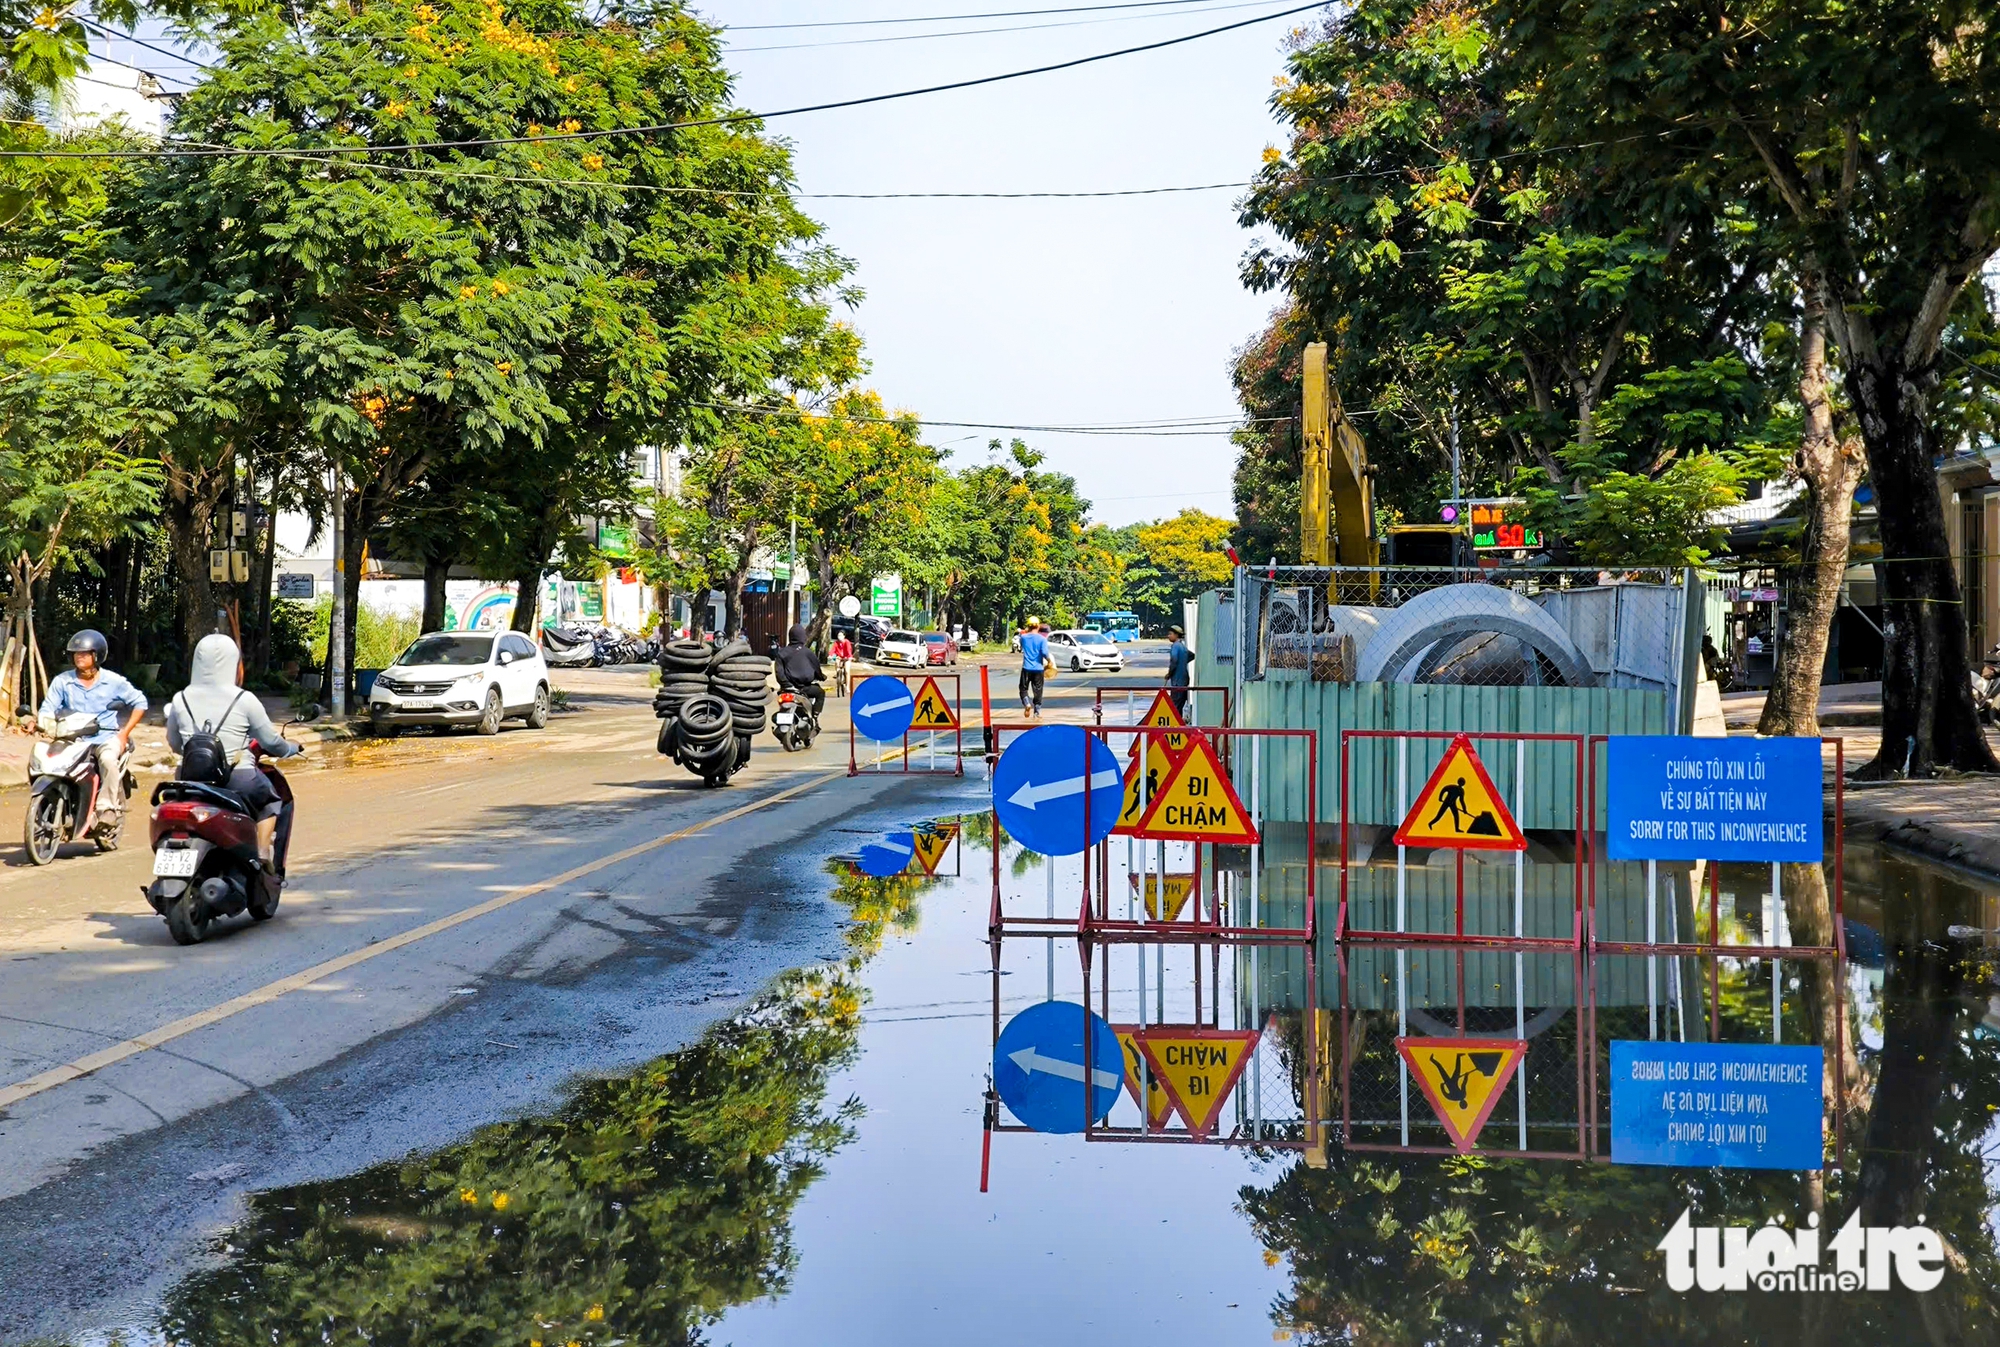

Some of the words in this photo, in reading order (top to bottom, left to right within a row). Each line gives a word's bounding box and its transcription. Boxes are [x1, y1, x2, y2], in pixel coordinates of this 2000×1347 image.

[1474, 530, 1495, 545] GIÁ
[1666, 755, 1703, 780] CHÚNG
[1706, 757, 1724, 780] TÔI
[1726, 761, 1745, 780] XIN
[1748, 752, 1765, 780] LỖI
[1187, 776, 1209, 797] ĐI
[1660, 783, 1674, 810] VỀ
[1677, 790, 1693, 813] SỰ
[1695, 784, 1715, 811] BẤT
[1718, 787, 1743, 813] TIỆN
[1746, 786, 1767, 811] NÀY
[1165, 802, 1226, 829] CHẬM
[1629, 820, 1664, 840] SORRY
[1667, 820, 1688, 840] FOR
[1691, 821, 1715, 841] THIS
[1720, 822, 1807, 843] INCONVENIENCE
